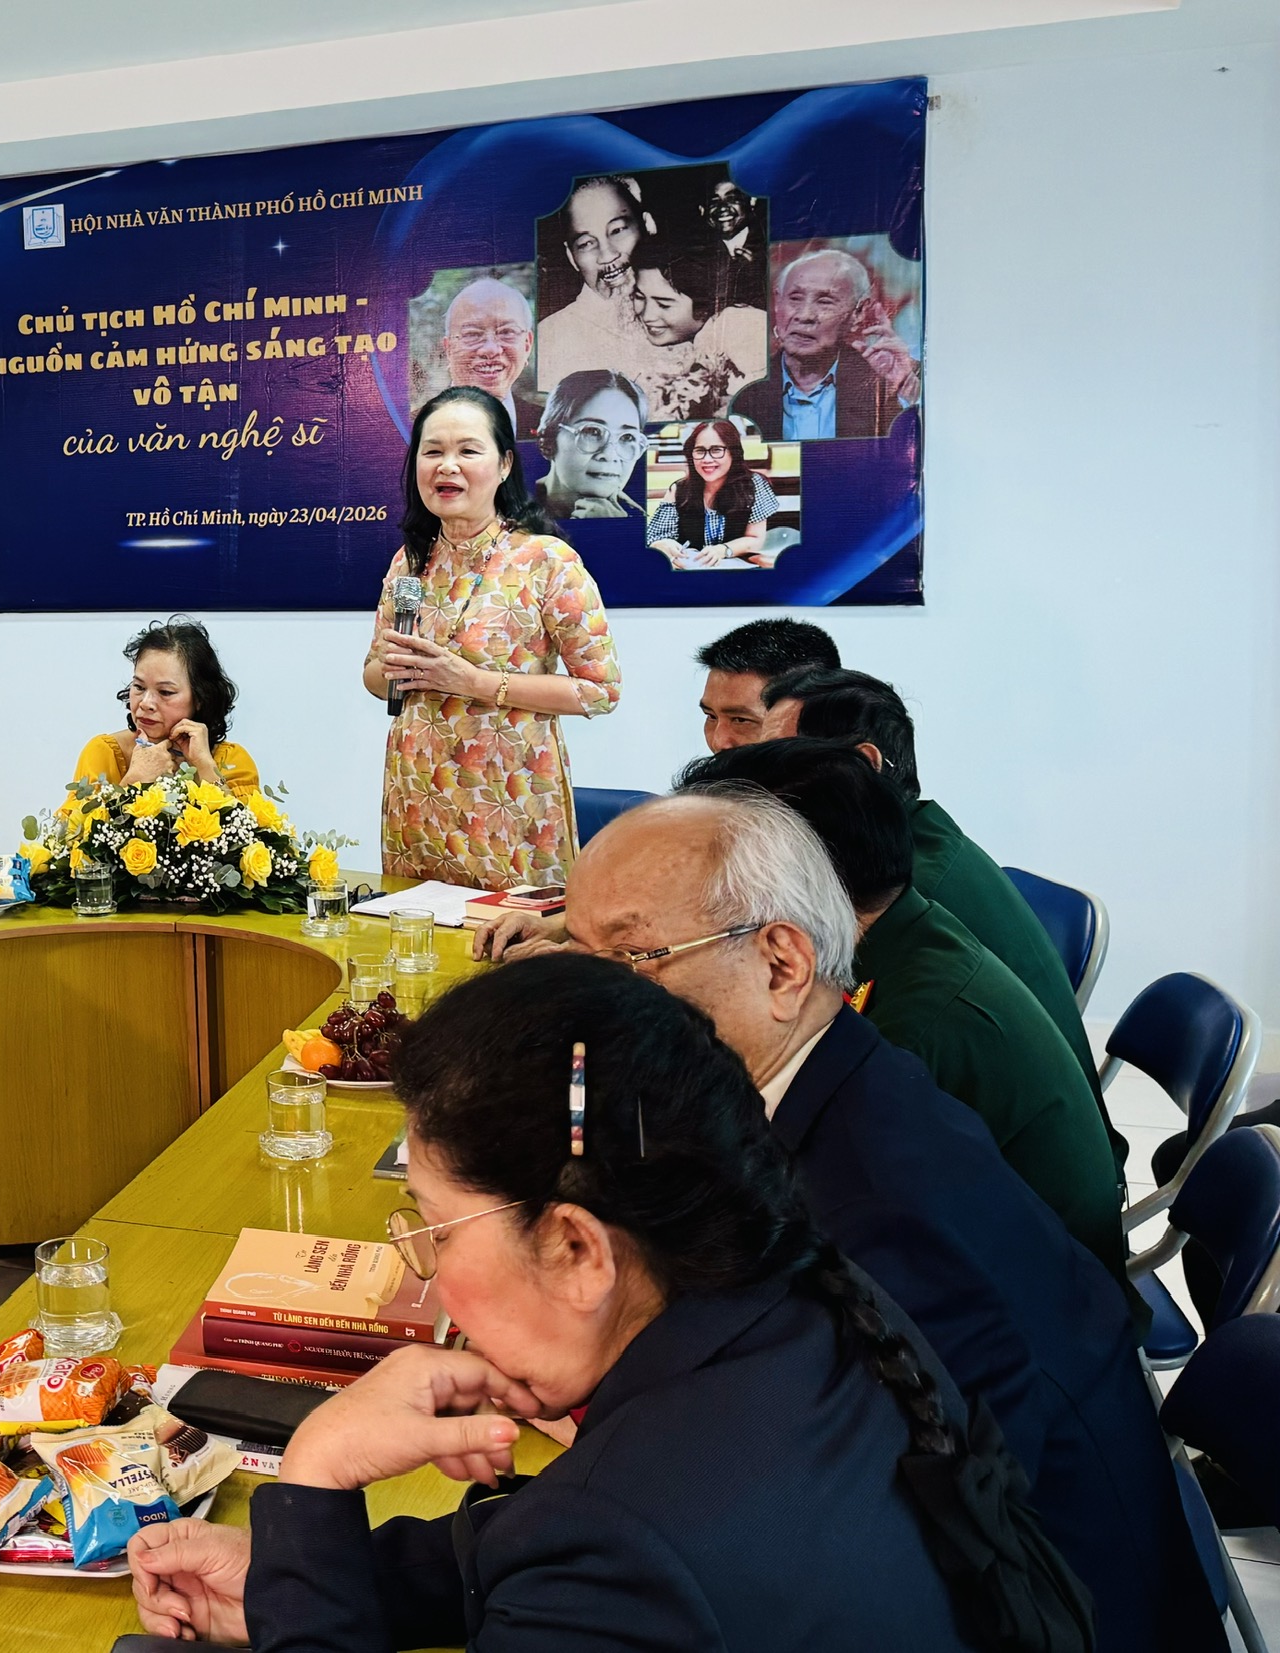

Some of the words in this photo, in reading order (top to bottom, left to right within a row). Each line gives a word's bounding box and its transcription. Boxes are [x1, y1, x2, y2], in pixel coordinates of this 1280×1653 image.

[70, 213, 103, 235] HỘI
[106, 209, 145, 230] NHÀ
[146, 206, 184, 225] VĂN
[186, 202, 252, 223] THÀNH
[255, 191, 295, 216] PHỐ
[298, 189, 326, 212] HỒ
[329, 188, 364, 209] CHÍ
[368, 184, 423, 206] MINH
[81, 309, 145, 337] TỊCH
[152, 294, 197, 326] HỒ
[204, 287, 257, 323] CHÍ
[263, 294, 347, 319] MINH
[90, 341, 148, 370] CẢM
[156, 337, 238, 366] HỨNG
[246, 326, 326, 361] SÁNG
[334, 331, 397, 361] TẠO
[133, 375, 172, 406] VÔ
[179, 378, 238, 411] TẬN
[63, 428, 119, 456] của
[128, 422, 191, 453] văn
[198, 409, 283, 461] nghệ
[291, 417, 329, 447] sĩ
[149, 508, 171, 527] Hồ
[172, 510, 199, 526] Chí
[201, 509, 246, 528] Minh,
[248, 508, 288, 528] ngày
[289, 505, 388, 526] 23/04/2026
[304, 1256, 321, 1273] LÀNG
[314, 1240, 330, 1257] SEN
[283, 1312, 303, 1324] LÀNG
[303, 1316, 319, 1326] SEN
[351, 1319, 367, 1331] NHÀ
